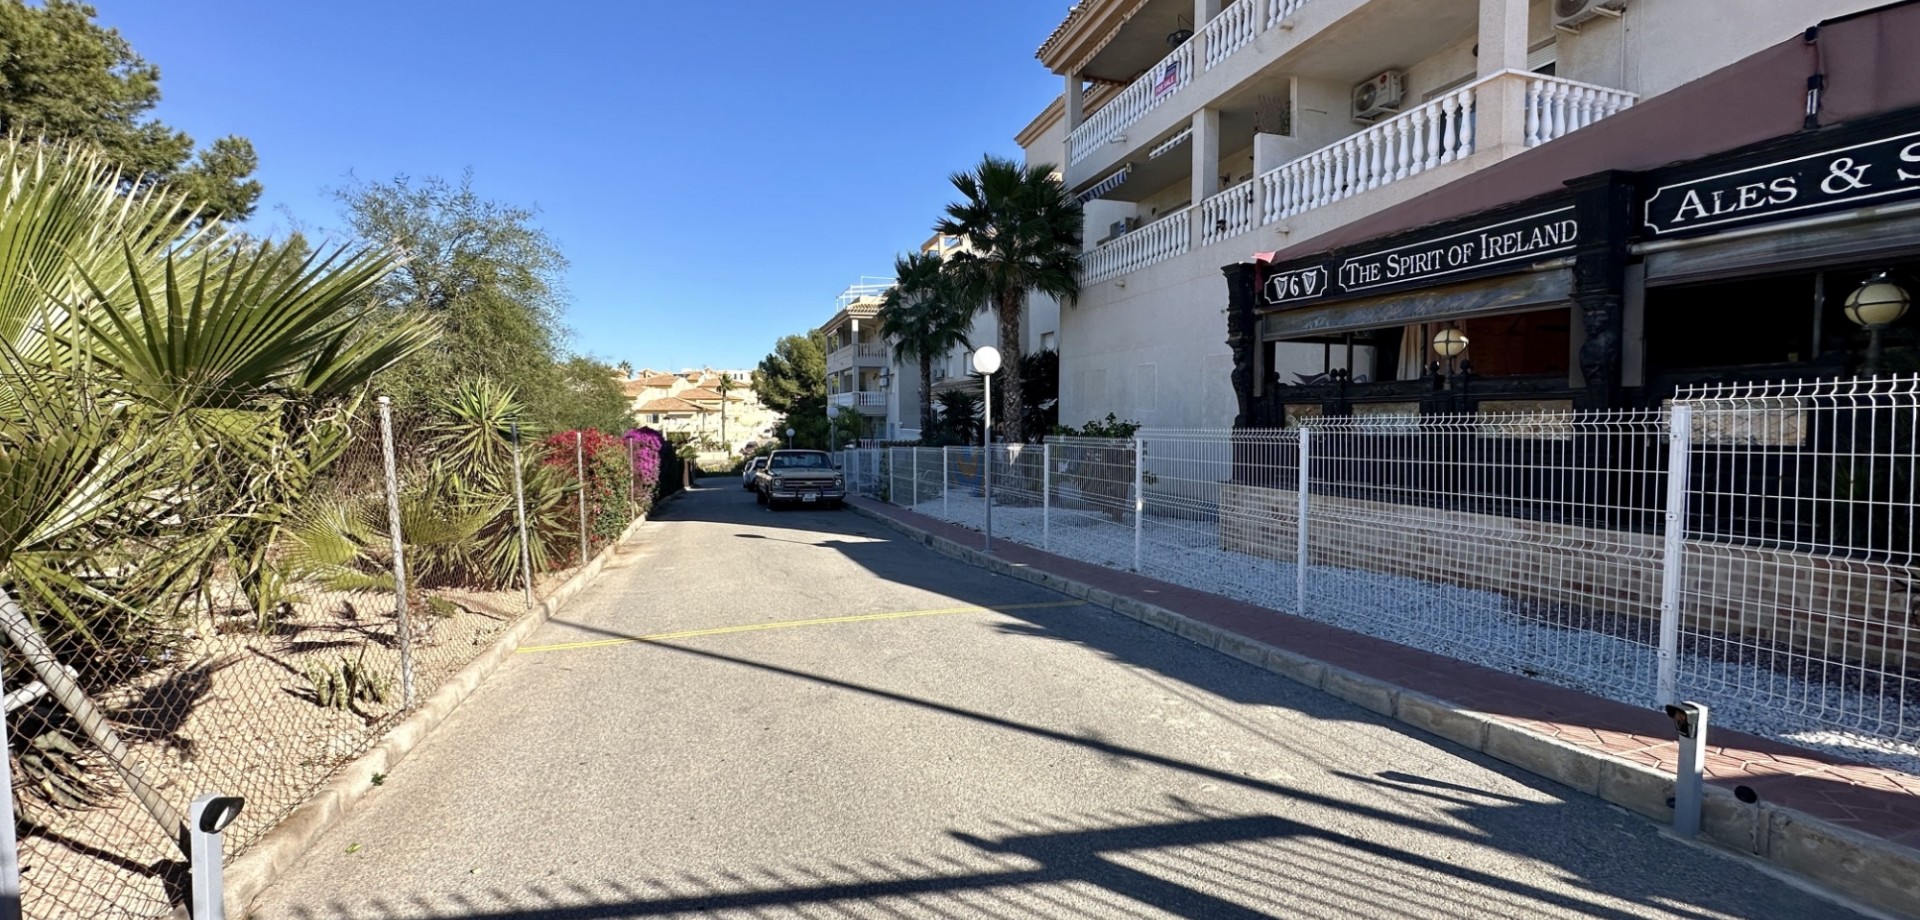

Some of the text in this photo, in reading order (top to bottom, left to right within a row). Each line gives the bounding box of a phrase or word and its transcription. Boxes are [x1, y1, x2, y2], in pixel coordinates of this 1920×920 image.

[1670, 176, 1798, 223] ALES
[1820, 157, 1872, 194] &
[1346, 219, 1578, 285] THE SPIRIT OF IRELAND
